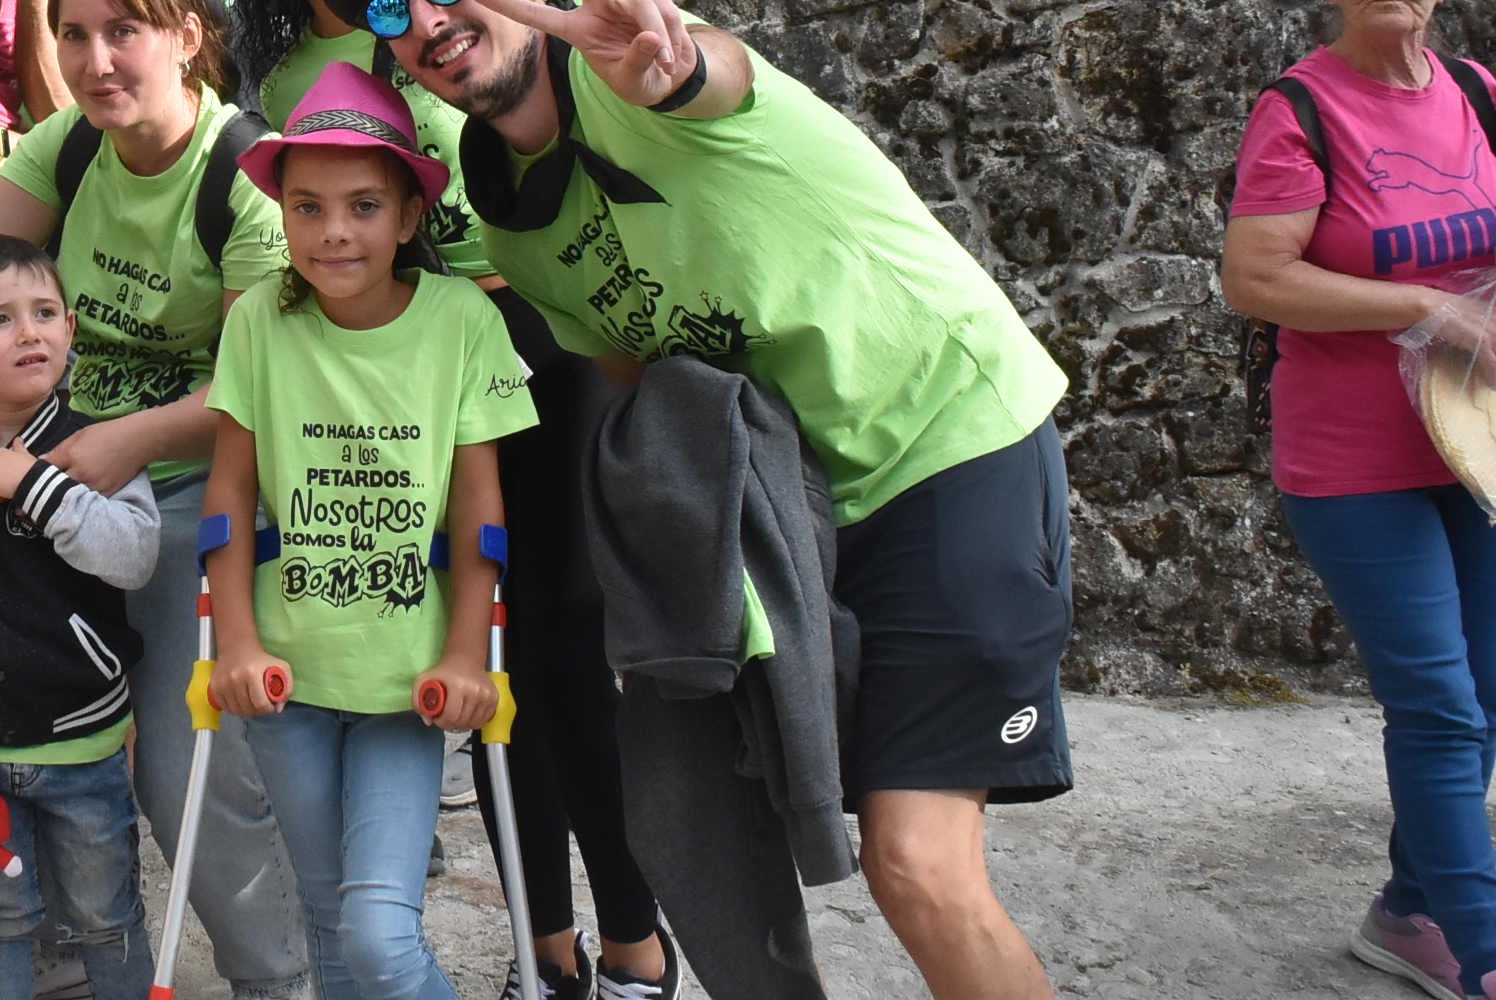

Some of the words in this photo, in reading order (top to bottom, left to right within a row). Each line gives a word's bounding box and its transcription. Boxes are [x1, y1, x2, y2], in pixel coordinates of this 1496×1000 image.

[302, 423, 324, 438] NO
[327, 424, 376, 440] HAGAS
[378, 425, 421, 440] CASO
[341, 445, 351, 463] a
[306, 468, 425, 488] PETARDOS...
[282, 531, 346, 548] SOMOS
